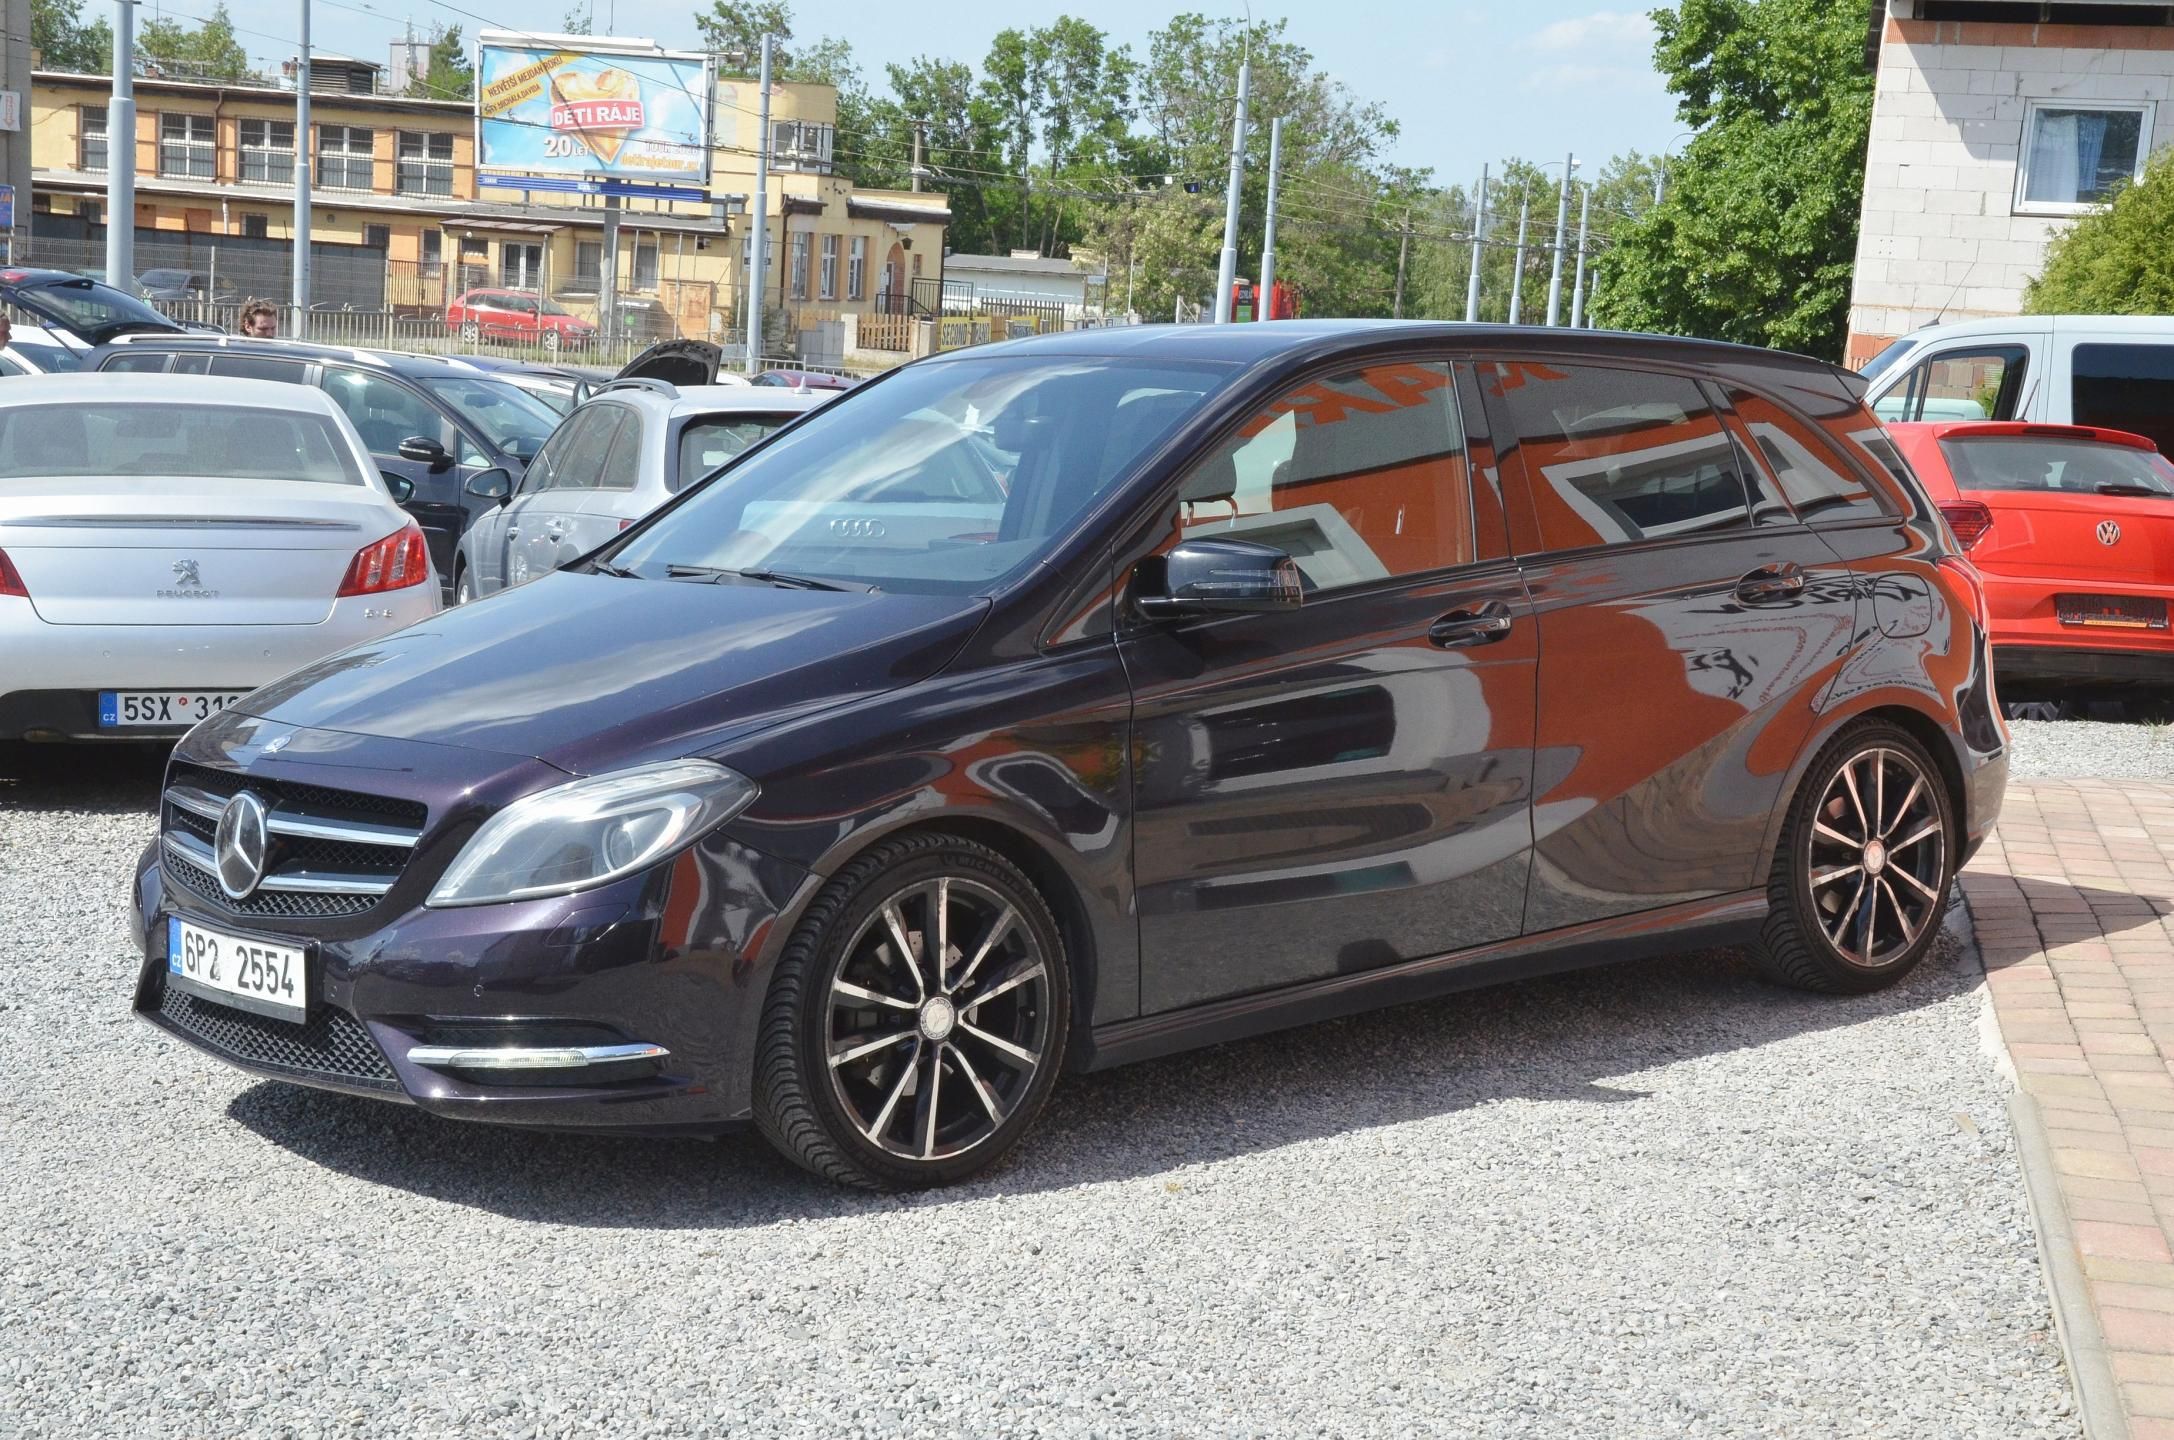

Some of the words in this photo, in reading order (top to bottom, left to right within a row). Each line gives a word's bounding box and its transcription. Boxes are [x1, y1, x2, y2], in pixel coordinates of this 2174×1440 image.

[596, 103, 640, 122] RÁJE
[544, 135, 571, 157] 20
[156, 589, 220, 599] PEUGEOT
[103, 714, 116, 722] CZ
[124, 696, 172, 721] 5SX
[171, 953, 182, 967] CZ
[185, 930, 221, 981] 6P2
[236, 945, 295, 998] 2554
